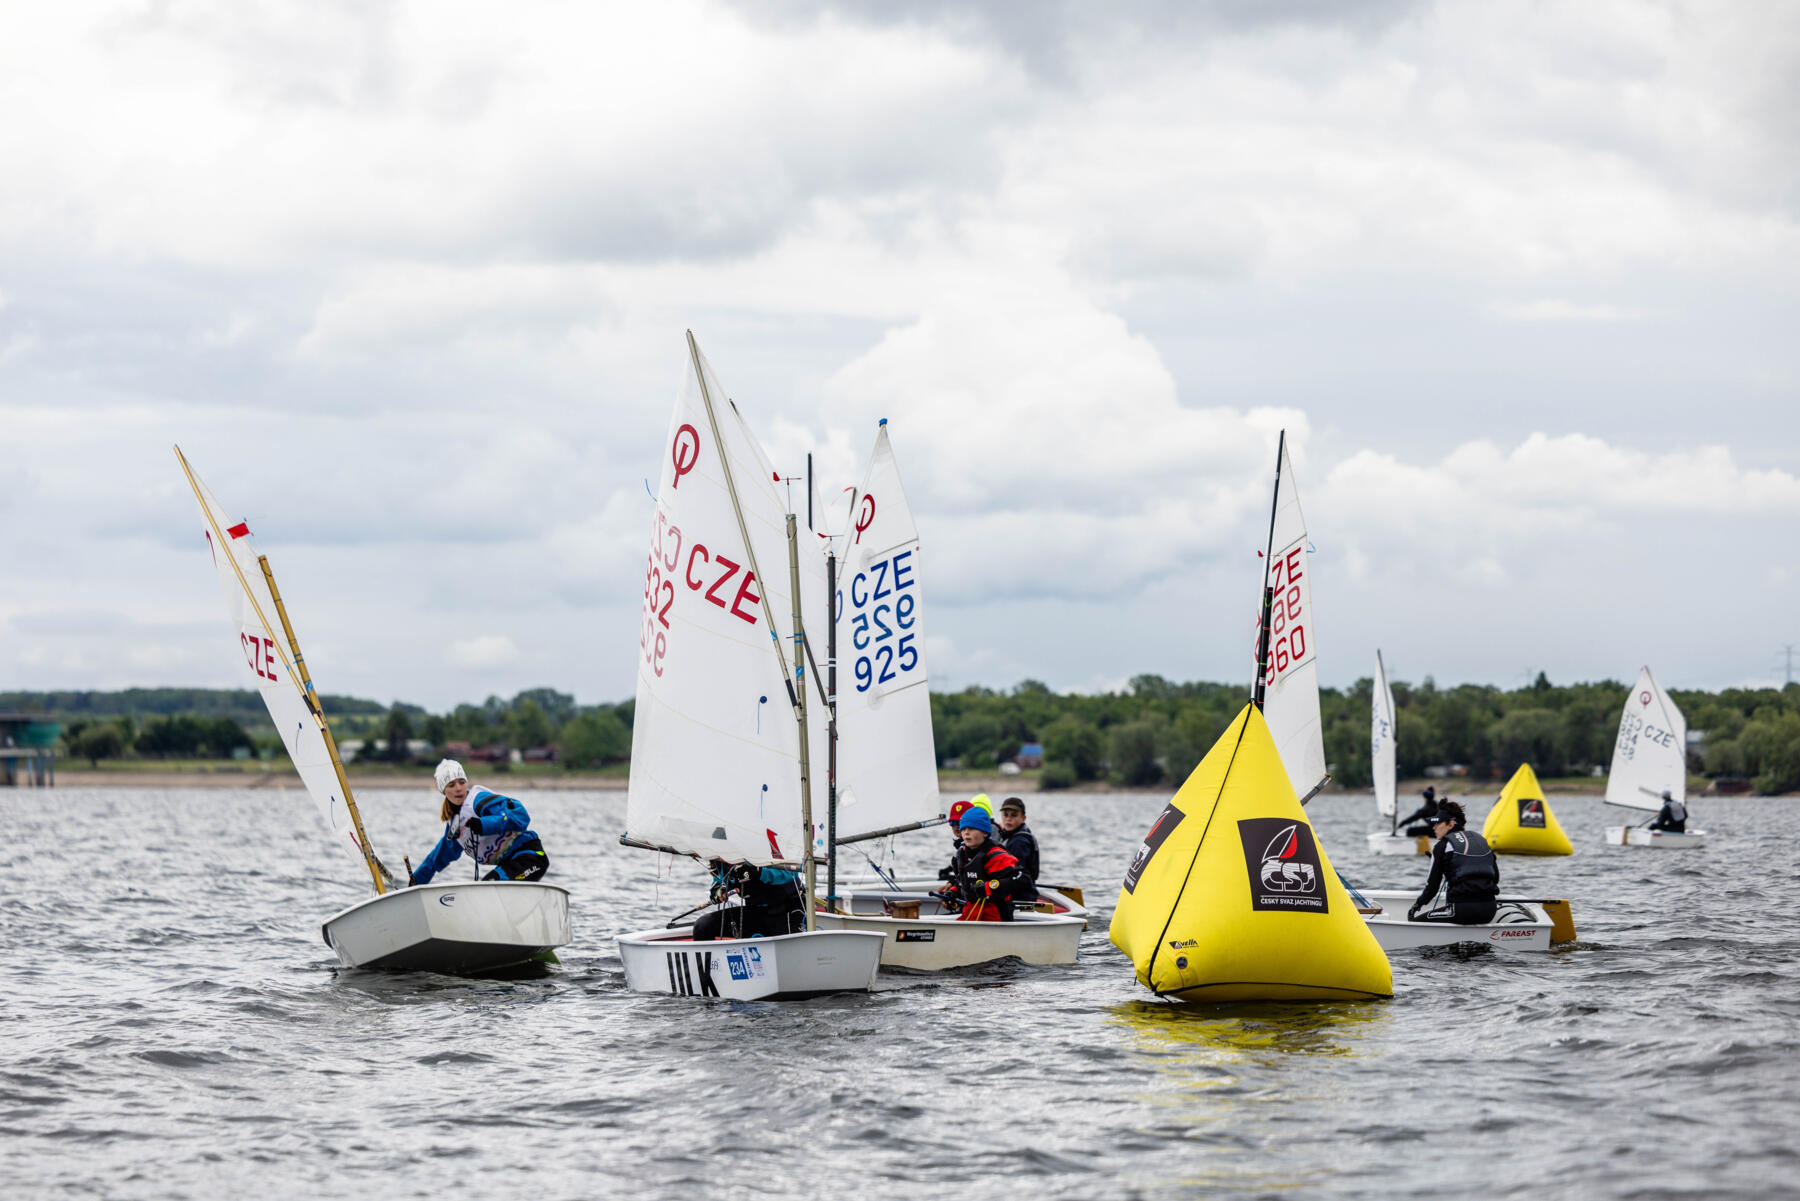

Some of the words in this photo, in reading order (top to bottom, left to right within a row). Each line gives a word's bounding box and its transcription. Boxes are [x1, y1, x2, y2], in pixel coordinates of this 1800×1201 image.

[686, 543, 761, 625] CZE
[852, 550, 915, 608] CZE
[241, 631, 278, 682] CZE
[854, 633, 918, 692] 925
[1266, 625, 1306, 686] 960
[1644, 725, 1675, 748] CZE
[1294, 899, 1323, 907] JACHTINGU
[1501, 930, 1537, 938] FAREAST
